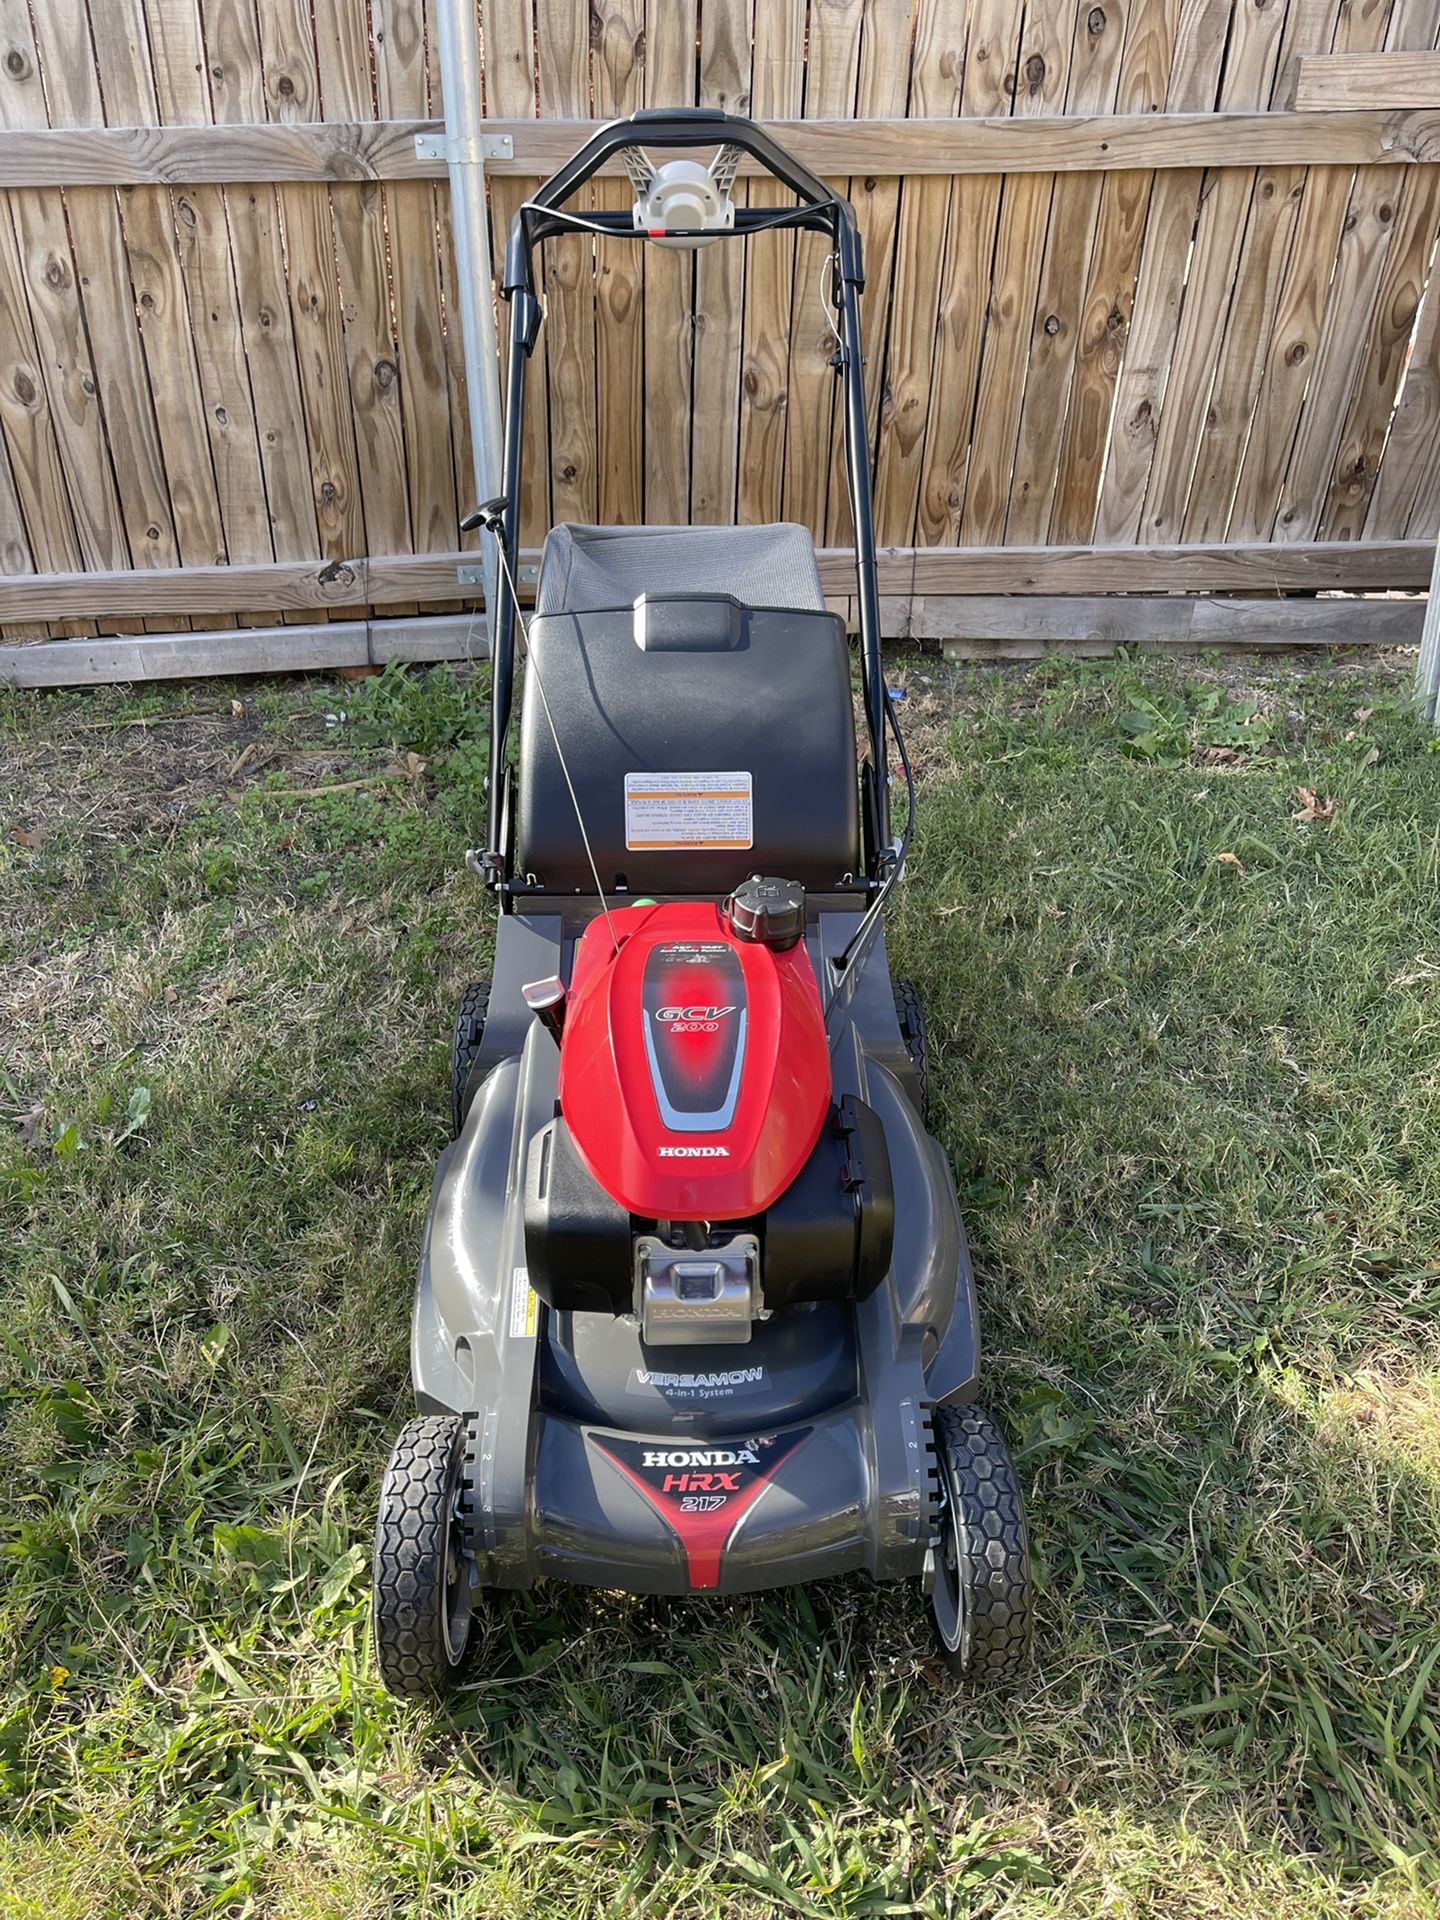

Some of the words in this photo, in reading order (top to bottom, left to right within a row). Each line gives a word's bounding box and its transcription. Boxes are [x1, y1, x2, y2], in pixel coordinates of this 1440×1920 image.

[655, 1006, 737, 1021] GCV
[670, 1022, 720, 1032] 200
[658, 1147, 730, 1157] HONDA
[652, 1308, 742, 1319] HONDA
[636, 1366, 764, 1387] VERSAMOW
[665, 1388, 696, 1398] 4-in-1
[699, 1387, 734, 1399] System
[908, 1441, 918, 1449] 2
[482, 1453, 492, 1461] 2
[642, 1450, 760, 1468] HONDA
[662, 1472, 742, 1492] HRX
[680, 1496, 727, 1511] 217
